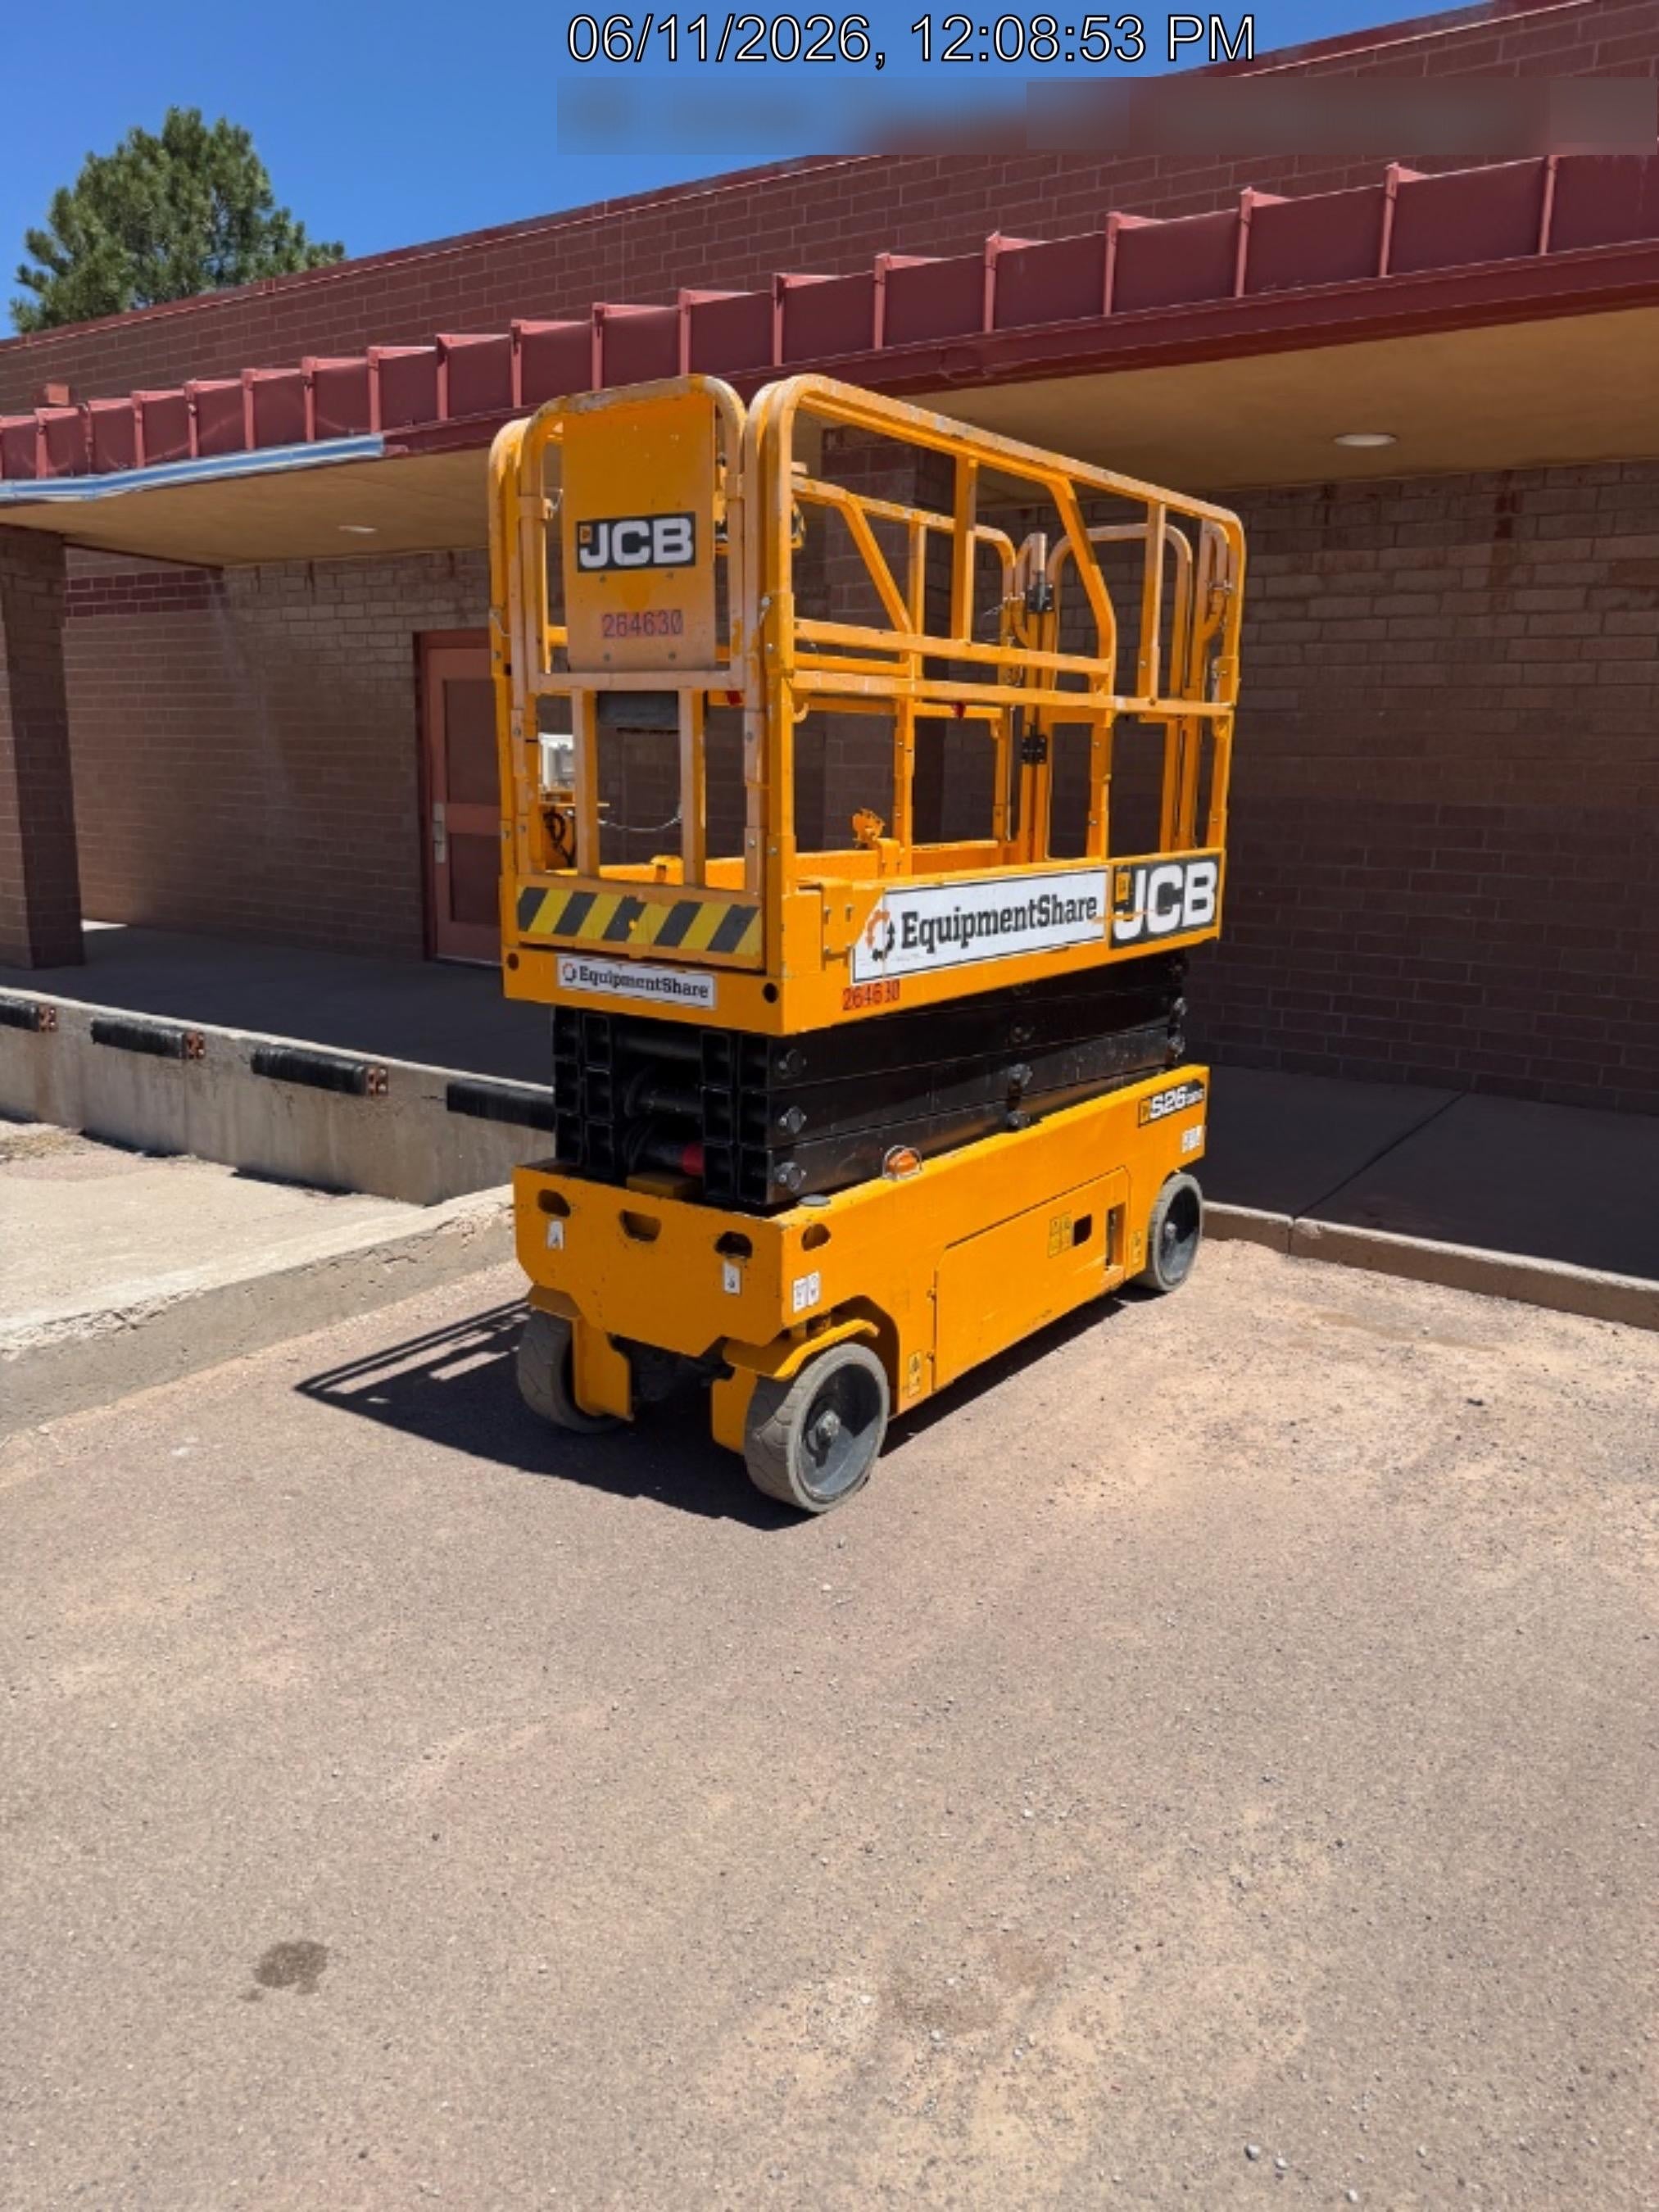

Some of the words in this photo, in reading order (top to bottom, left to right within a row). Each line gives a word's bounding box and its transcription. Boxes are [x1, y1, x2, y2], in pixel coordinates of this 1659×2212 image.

[579, 518, 692, 568] JCB
[601, 609, 684, 638] 264630
[901, 894, 1098, 953] EquipmentShare
[1113, 861, 1217, 941] JCB
[579, 965, 709, 998] EquipmentShare
